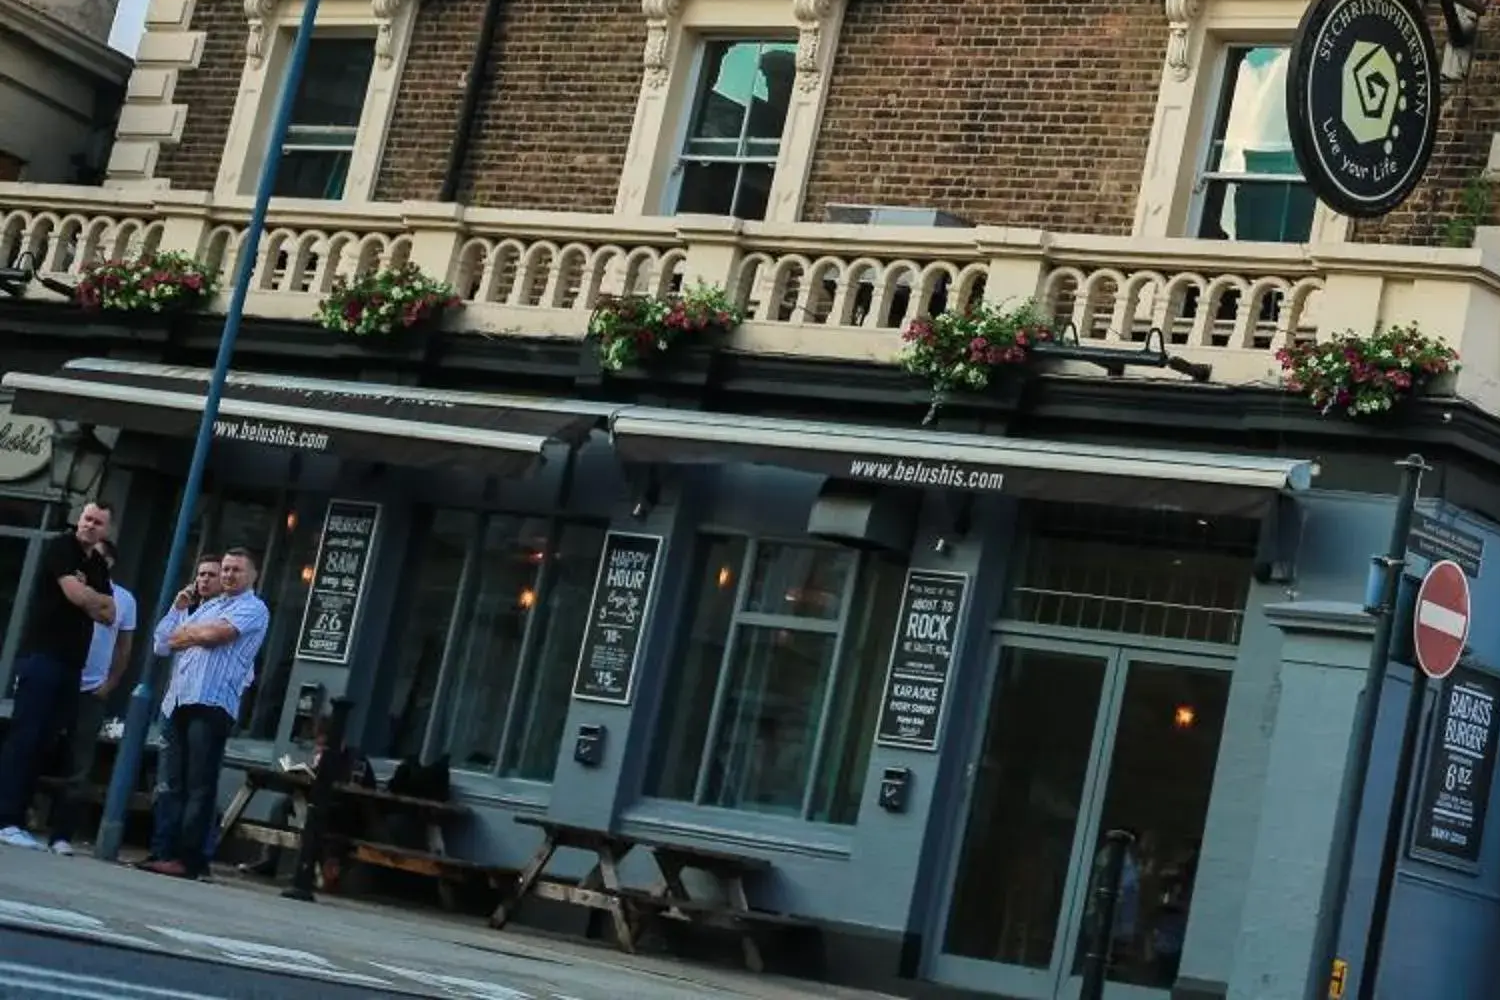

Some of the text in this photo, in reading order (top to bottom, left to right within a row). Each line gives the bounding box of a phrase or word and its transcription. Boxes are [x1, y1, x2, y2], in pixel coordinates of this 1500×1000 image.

[1414, 68, 1427, 118] INN
[1322, 116, 1399, 183] Live your Life
[850, 459, 1004, 489] www.belushis.com
[606, 567, 645, 589] HOUR
[906, 613, 951, 641] ROCK
